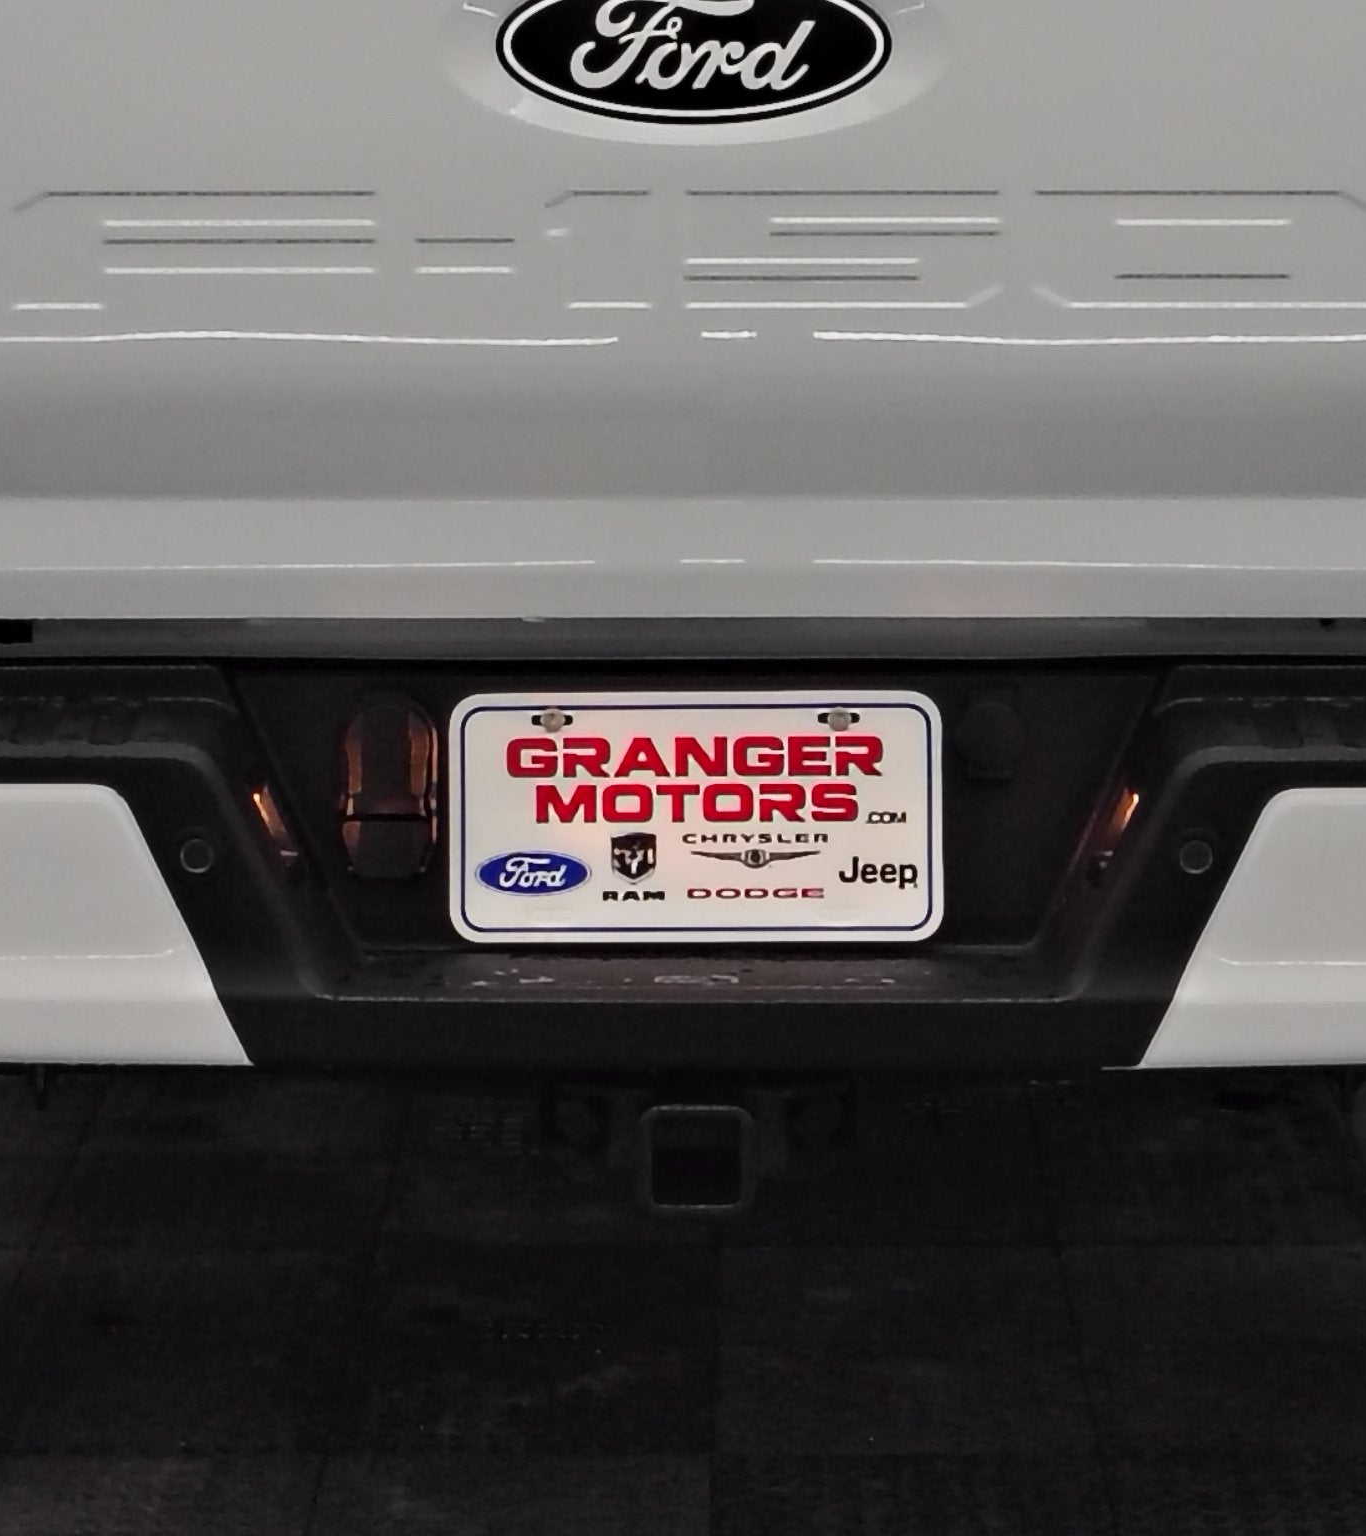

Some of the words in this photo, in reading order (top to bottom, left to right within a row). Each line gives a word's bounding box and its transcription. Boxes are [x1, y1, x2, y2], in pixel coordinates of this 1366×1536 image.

[506, 735, 884, 778] GRANGER
[534, 782, 859, 824] MOTORS
[681, 832, 829, 845] CHRYSLER
[498, 855, 567, 888] Ford
[839, 855, 918, 889] Jeep
[601, 888, 666, 902] RAM
[686, 886, 825, 900] DODGE
